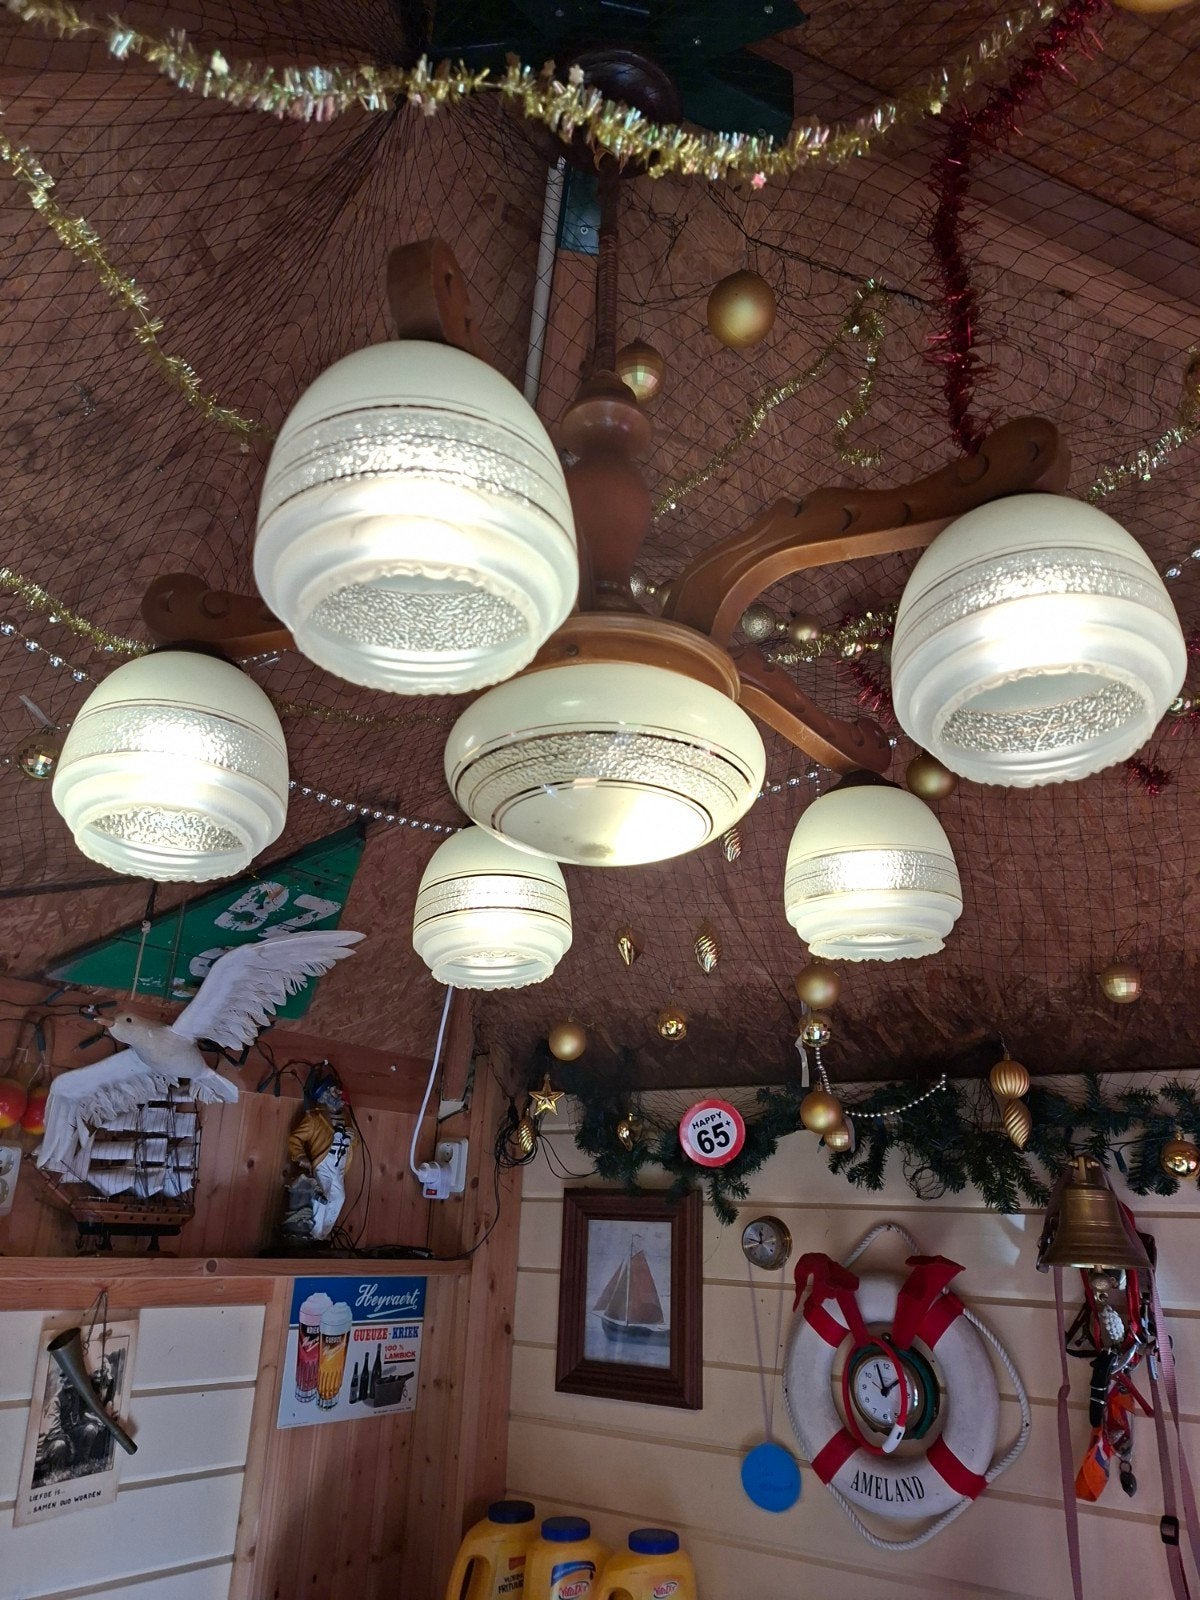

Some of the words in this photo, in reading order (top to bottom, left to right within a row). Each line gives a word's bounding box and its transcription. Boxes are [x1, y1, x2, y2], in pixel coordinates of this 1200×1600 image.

[692, 1111, 722, 1130] HAPPY
[697, 1120, 731, 1154] 65+
[355, 1283, 420, 1313] Heyvaert
[384, 1344, 398, 1353] 100
[384, 1350, 416, 1360] LAMBICK
[850, 1469, 925, 1503] AMELAND
